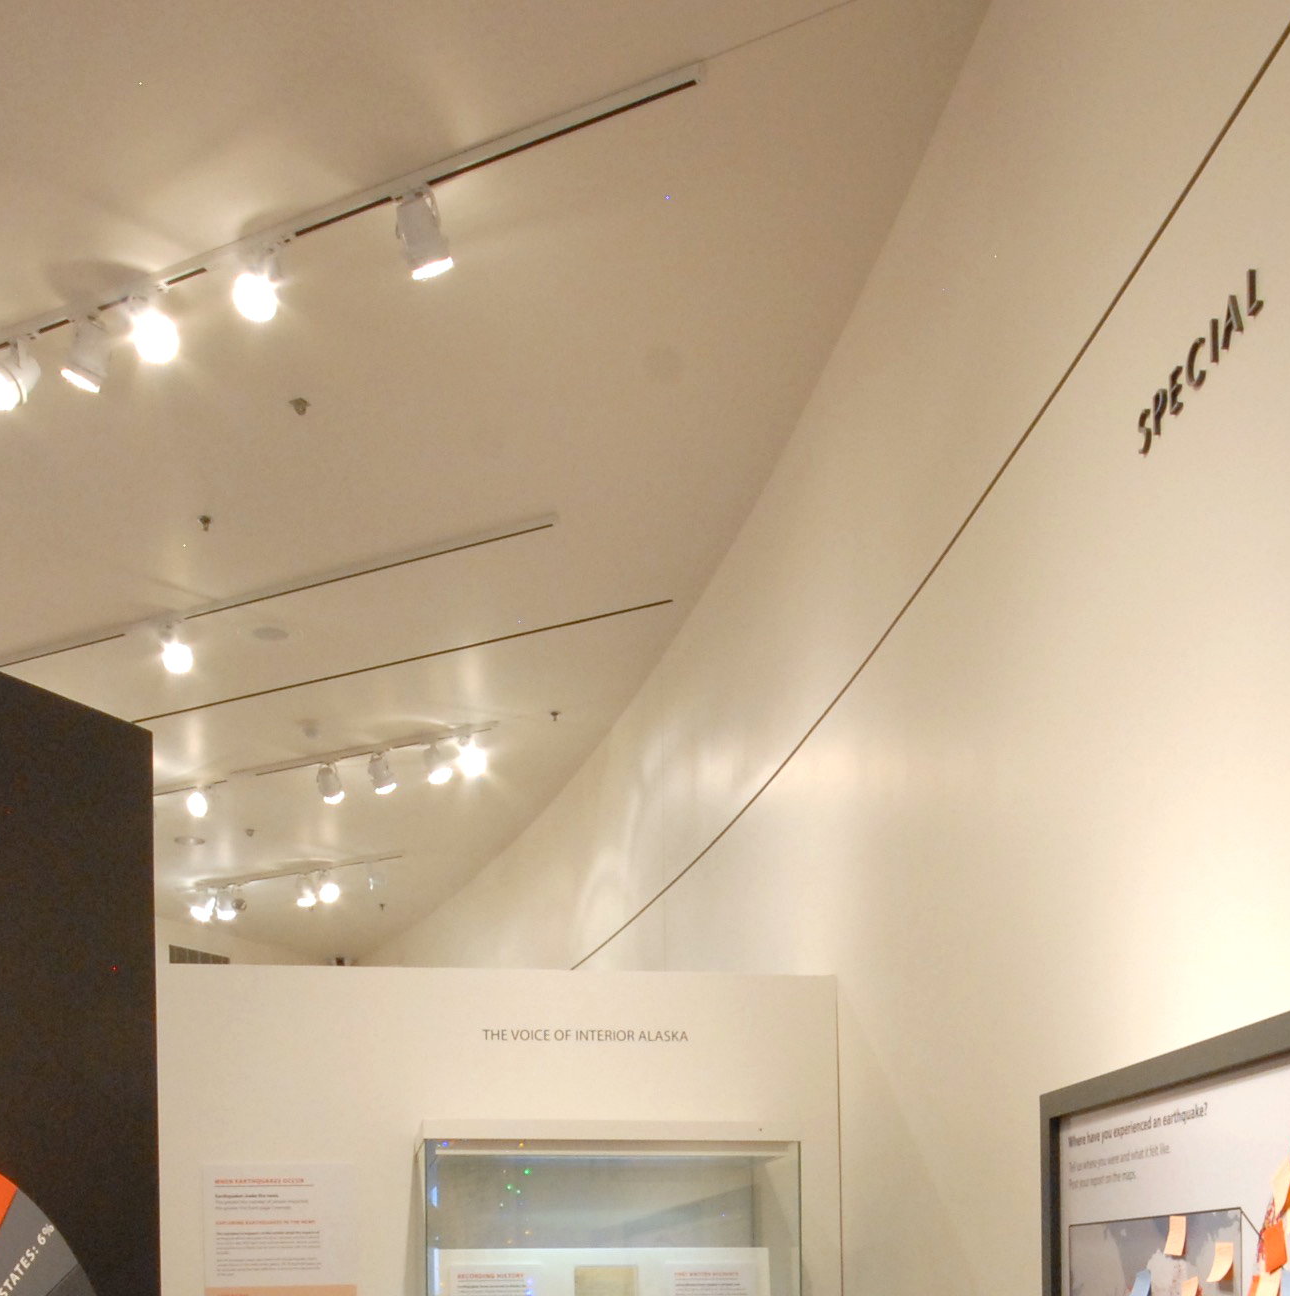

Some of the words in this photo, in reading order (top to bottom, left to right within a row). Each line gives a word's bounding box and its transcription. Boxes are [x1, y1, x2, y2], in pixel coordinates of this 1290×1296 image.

[1137, 268, 1264, 456] SPECIAL
[482, 1029, 507, 1041] THE
[511, 1029, 549, 1041] VOICE
[554, 1030, 571, 1041] OF
[576, 1030, 634, 1041] INTERIOR
[639, 1031, 688, 1042] ALASKA
[36, 1223, 55, 1246] 6%
